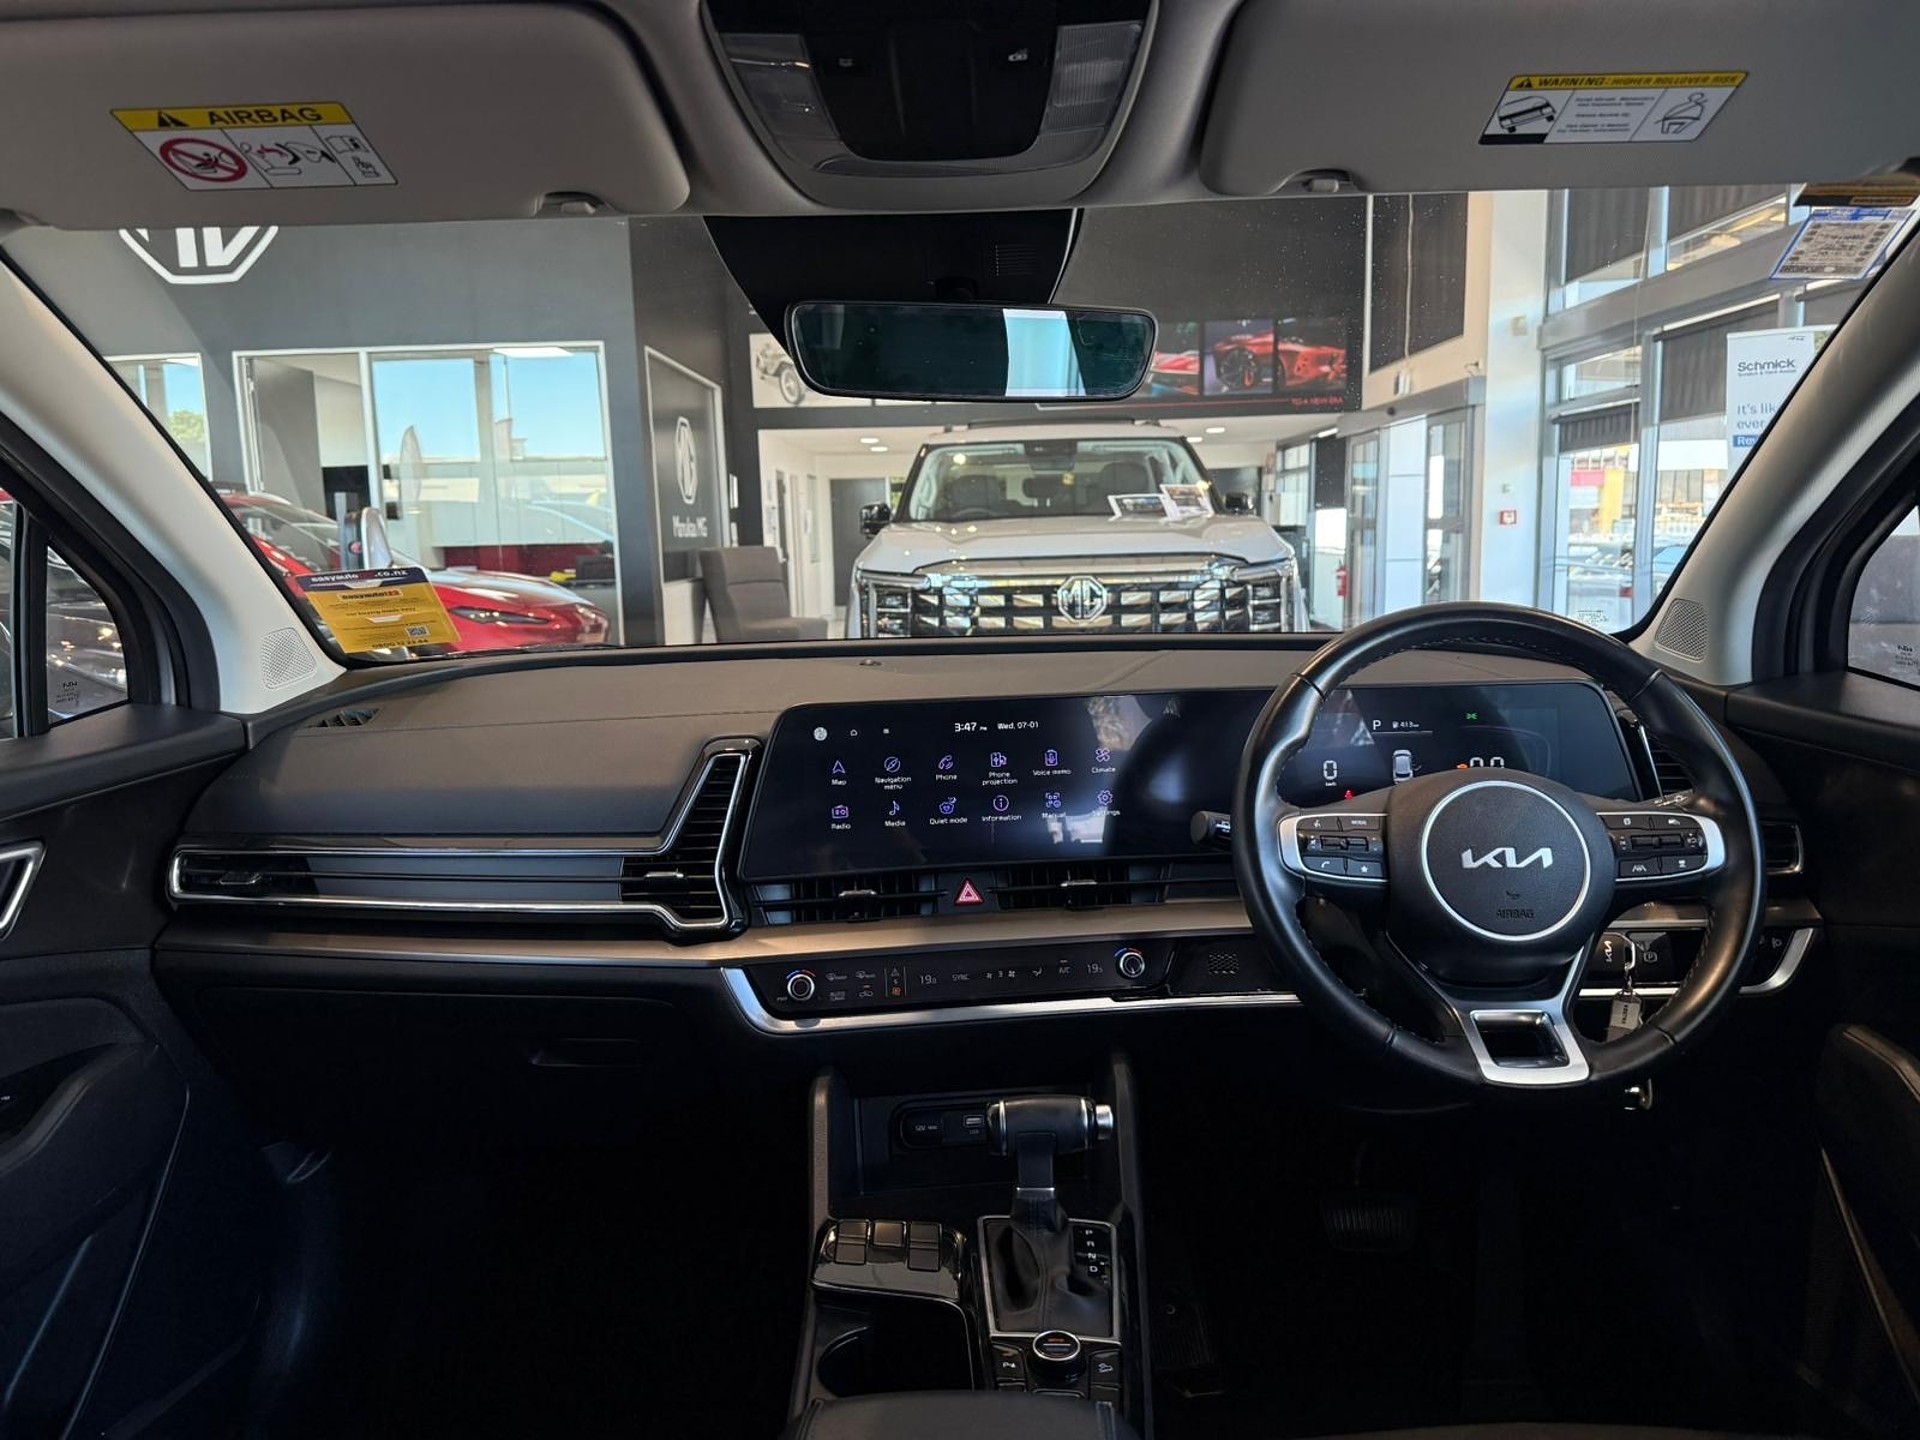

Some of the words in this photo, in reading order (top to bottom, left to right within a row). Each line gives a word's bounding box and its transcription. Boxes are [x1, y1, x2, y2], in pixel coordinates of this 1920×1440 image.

[1611, 76, 1654, 86] HIGHER
[1655, 75, 1710, 85] ROLLOVER
[1713, 74, 1739, 84] RISK
[208, 106, 322, 125] AIRBAG
[1737, 359, 1796, 372] Schmick
[1059, 578, 1104, 620] MG
[954, 722, 977, 733] 3:47
[1016, 721, 1039, 730] 07-01
[1373, 720, 1382, 731] P
[1033, 769, 1051, 777] Voice
[1323, 760, 1338, 780] 0
[875, 775, 912, 785] Navigation
[936, 773, 958, 781] Phone
[982, 777, 1018, 786] projection
[929, 817, 948, 826] Quiet
[981, 813, 1022, 822] Information
[884, 819, 906, 827] Media
[1461, 847, 1553, 869] KIA
[1087, 1252, 1097, 1260] N
[1089, 1265, 1098, 1273] D
